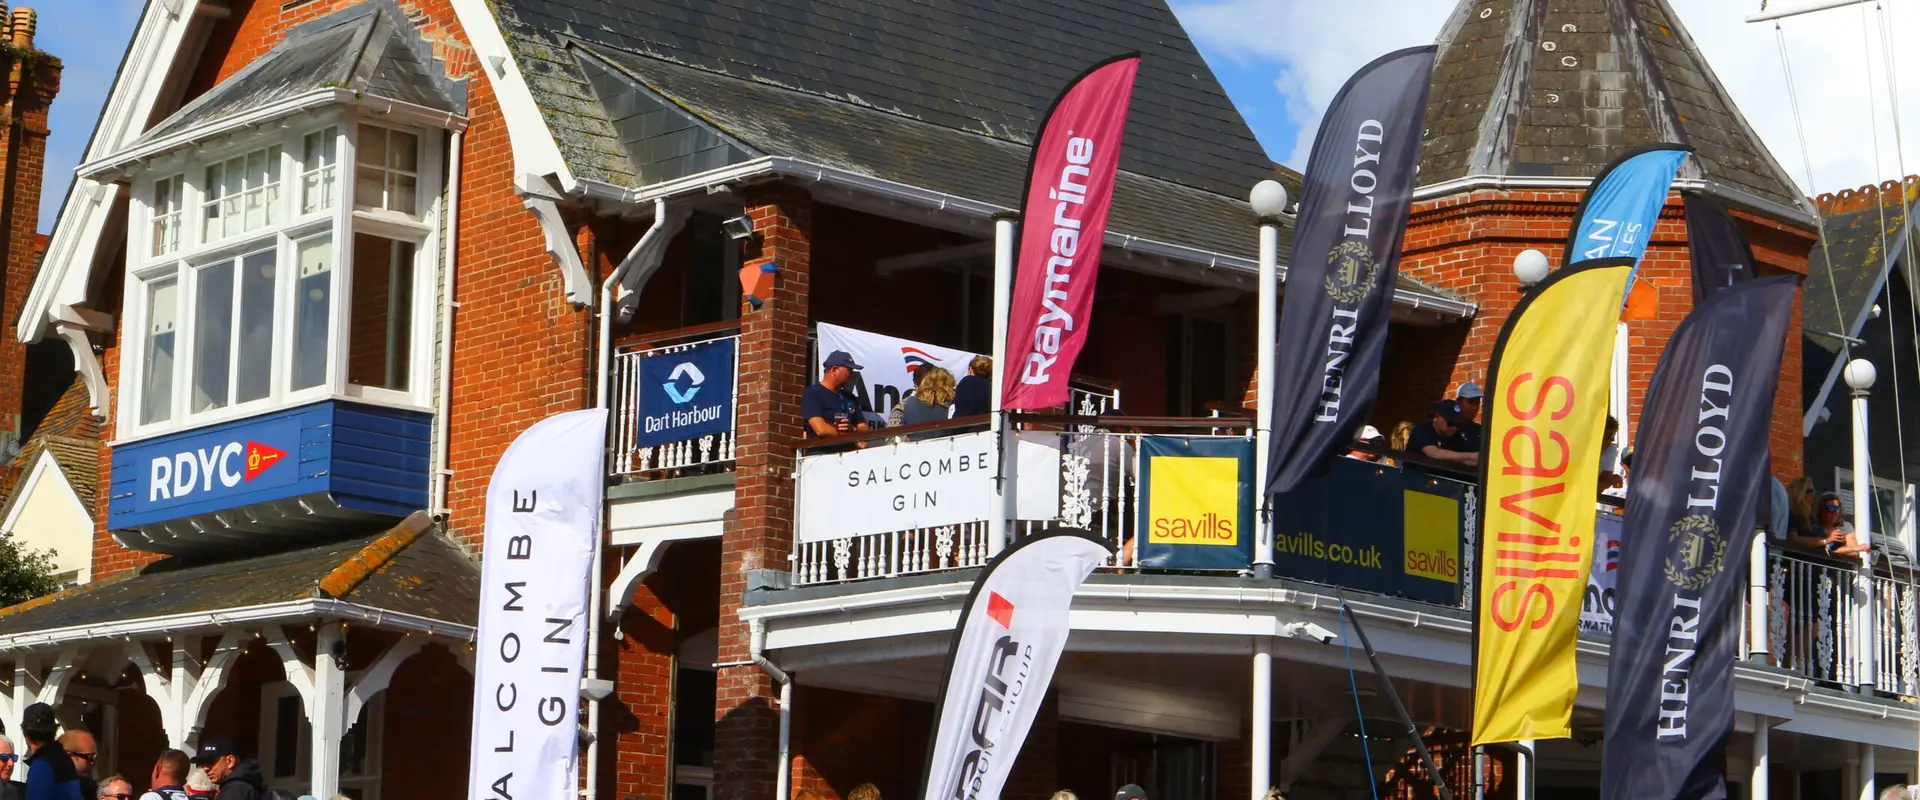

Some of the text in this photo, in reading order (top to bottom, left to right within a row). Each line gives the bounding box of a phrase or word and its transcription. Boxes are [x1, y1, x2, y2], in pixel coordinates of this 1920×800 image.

[1022, 136, 1095, 386] Raymarine
[1617, 222, 1643, 258] LES
[1314, 118, 1384, 424] HENRI LLOYD
[645, 404, 722, 433] Dart Harbour
[150, 441, 243, 502] RDYC
[848, 451, 989, 488] SALCOMBE
[892, 490, 938, 511] GIN
[1490, 372, 1581, 632] savills
[1154, 512, 1233, 540] savills
[1273, 532, 1382, 569] avills.co.uk
[1407, 550, 1457, 577] savills
[1656, 363, 1734, 740] HENRI LLOYD
[484, 489, 537, 800] ALCOMBE
[538, 617, 573, 727] GIN
